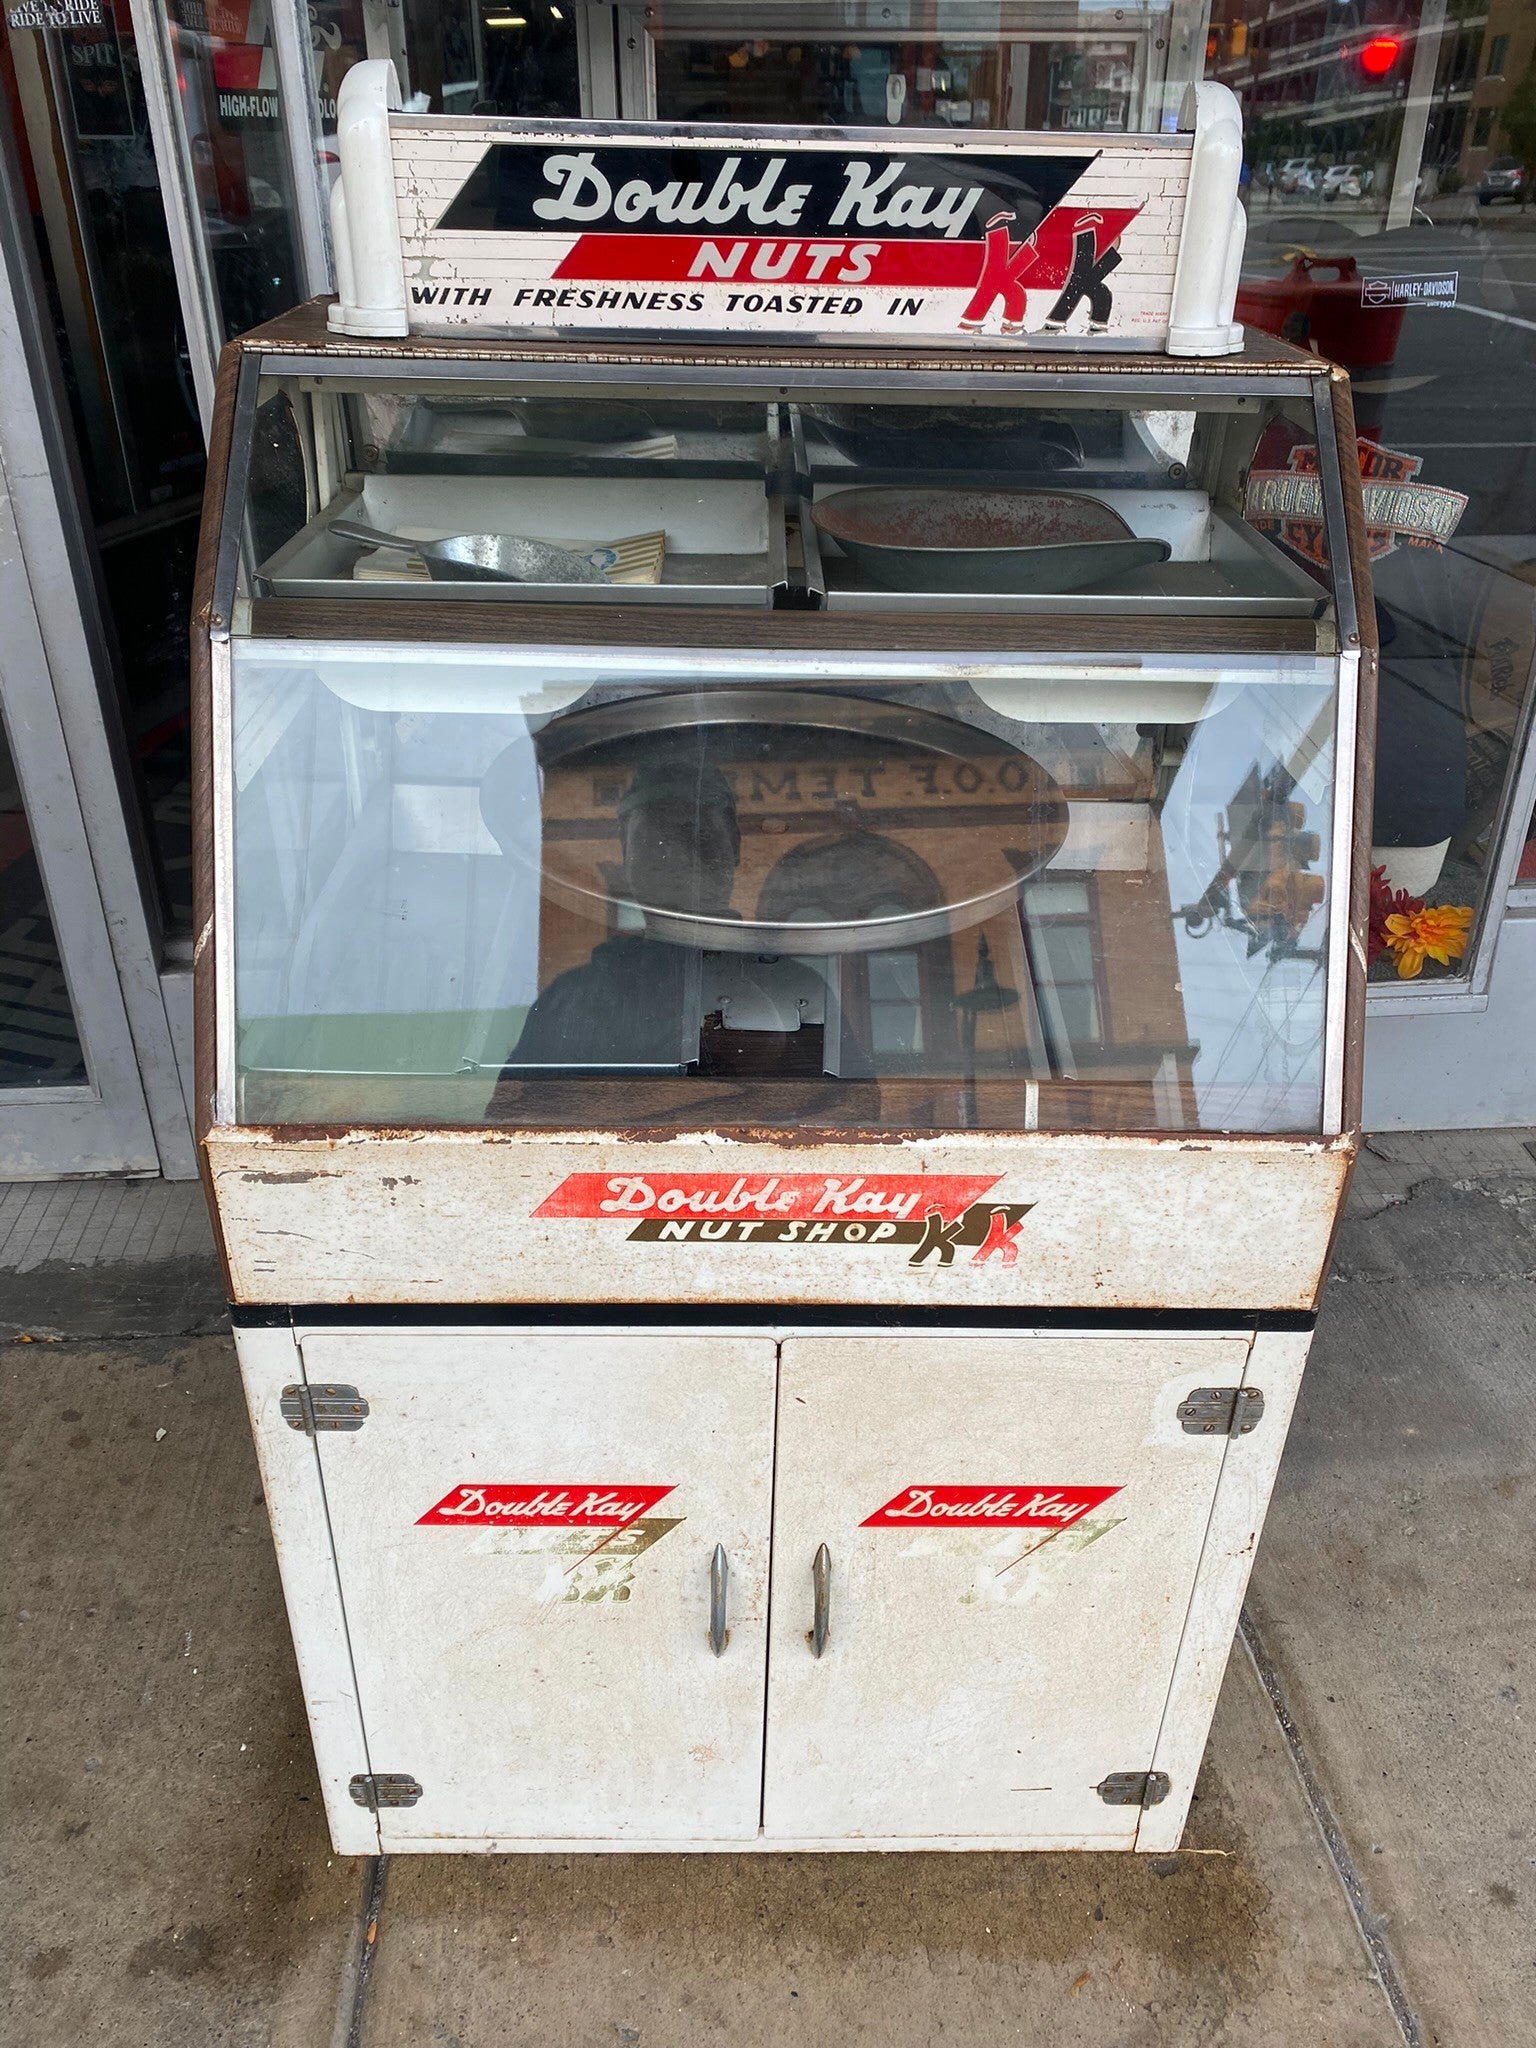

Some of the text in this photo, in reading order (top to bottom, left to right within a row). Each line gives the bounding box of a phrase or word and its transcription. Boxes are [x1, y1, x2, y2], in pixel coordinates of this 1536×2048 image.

[10, 12, 45, 28] RIDE
[70, 11, 102, 25] LIVE
[219, 94, 279, 119] HIGH-FLOW
[533, 152, 984, 238] Double Kay
[687, 242, 882, 283] NUTS
[411, 286, 924, 316] WITH FRESHNESS TOASTED IN
[1394, 280, 1456, 298] HARLEY-DAVIDSON
[600, 1177, 923, 1220] Double Kay
[657, 1221, 898, 1243] NUT SHOP
[438, 1488, 646, 1522] Double Kay
[885, 1489, 1090, 1523] Double Kay
